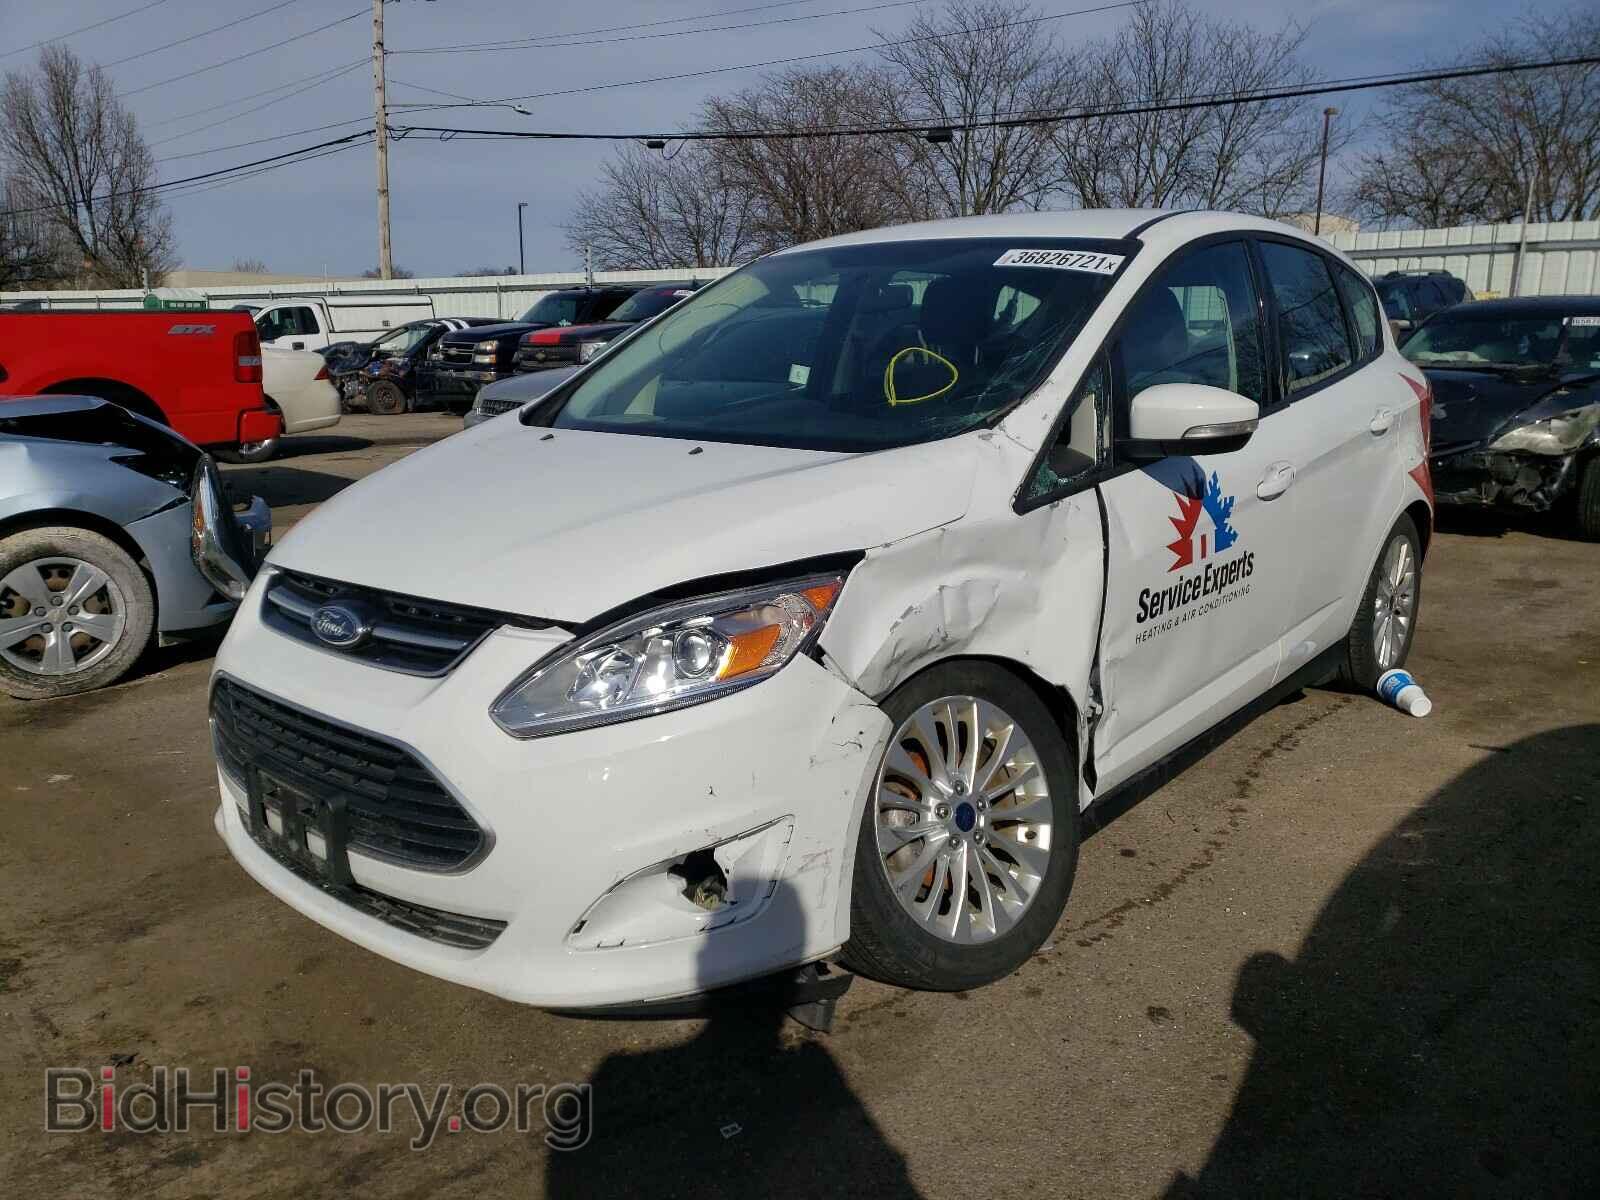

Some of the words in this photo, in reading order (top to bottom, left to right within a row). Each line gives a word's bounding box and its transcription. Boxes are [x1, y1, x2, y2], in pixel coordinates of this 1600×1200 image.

[1012, 251, 1107, 270] 36826721
[1136, 575, 1202, 624] Service
[1202, 550, 1255, 597] Experts
[316, 611, 350, 637] Ford
[1135, 618, 1173, 645] HEATING
[1173, 616, 1180, 628] &
[1181, 607, 1197, 624] AIR
[1198, 584, 1251, 616] CONDITIONING
